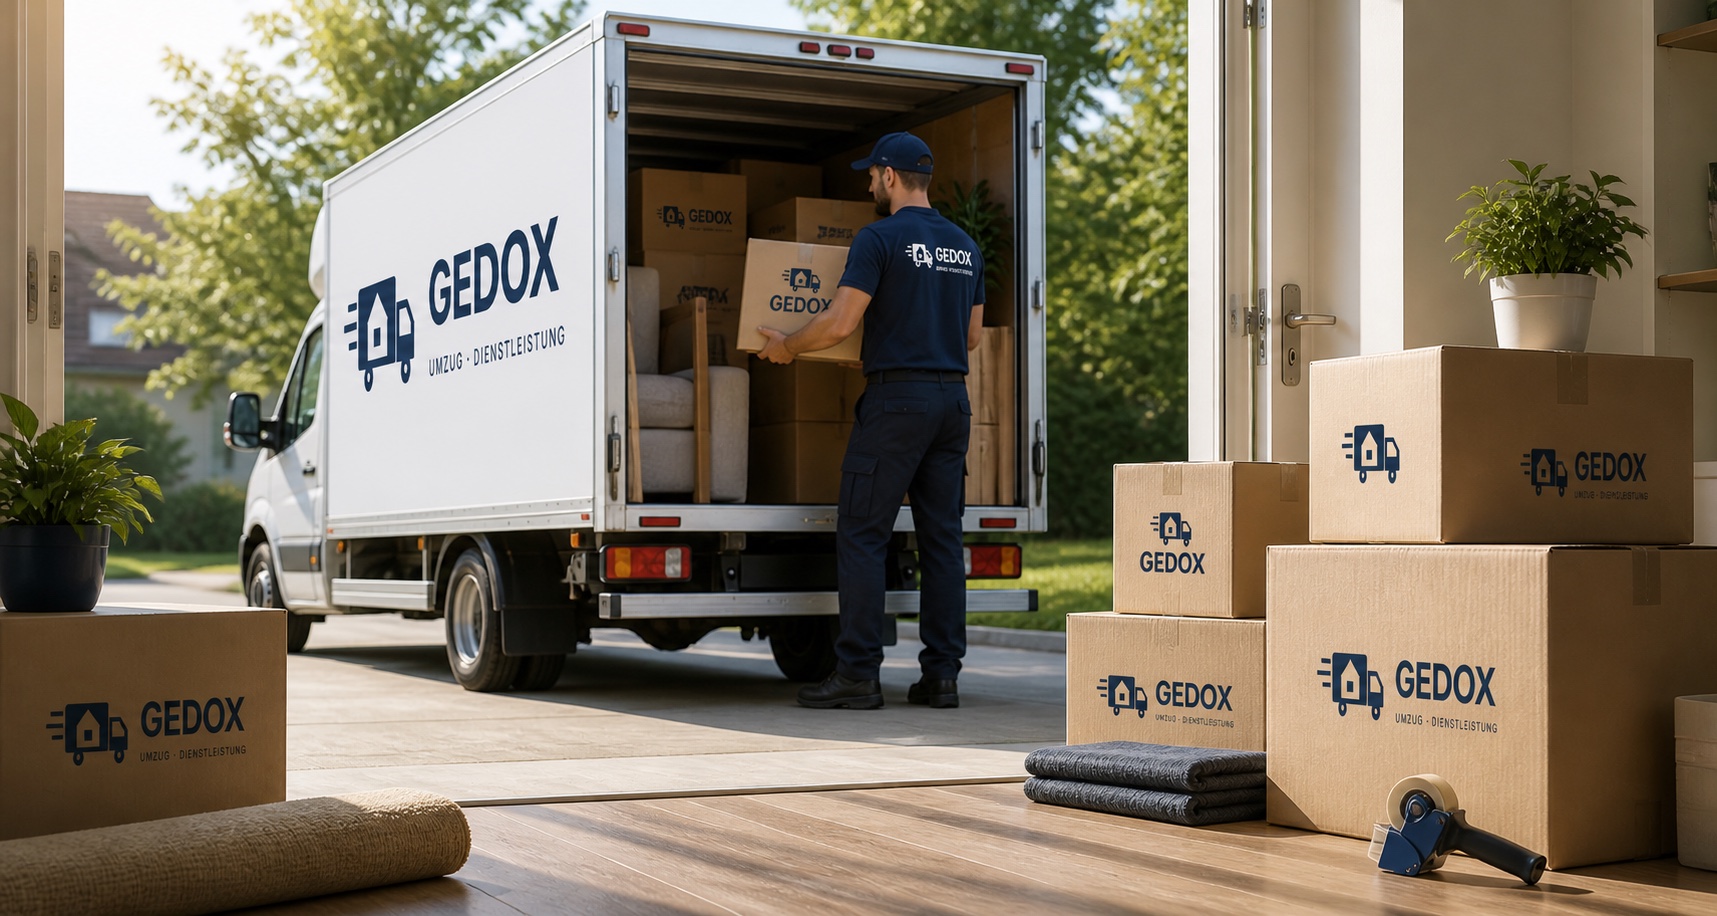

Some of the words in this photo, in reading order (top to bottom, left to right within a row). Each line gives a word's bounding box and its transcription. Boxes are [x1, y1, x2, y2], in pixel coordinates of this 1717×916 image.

[689, 208, 732, 225] GEDOX
[428, 215, 560, 326] GEDOX
[935, 247, 973, 267] GEDOX
[769, 294, 833, 315] GEDOX
[428, 352, 463, 377] UMZUG
[473, 325, 565, 367] DIENSTLEISTUNG
[1574, 451, 1648, 482] GEDOX
[1139, 550, 1206, 574] GEDOX
[1155, 680, 1233, 711] GEDOX
[1395, 659, 1496, 707] GEDOX
[140, 696, 245, 738] GEDOX
[1395, 713, 1423, 726] UMZUG
[1431, 716, 1498, 734] DIENSTLEISTUNG
[139, 751, 171, 762] UMZUG
[179, 745, 247, 760] DIENSTLEISTUNG
